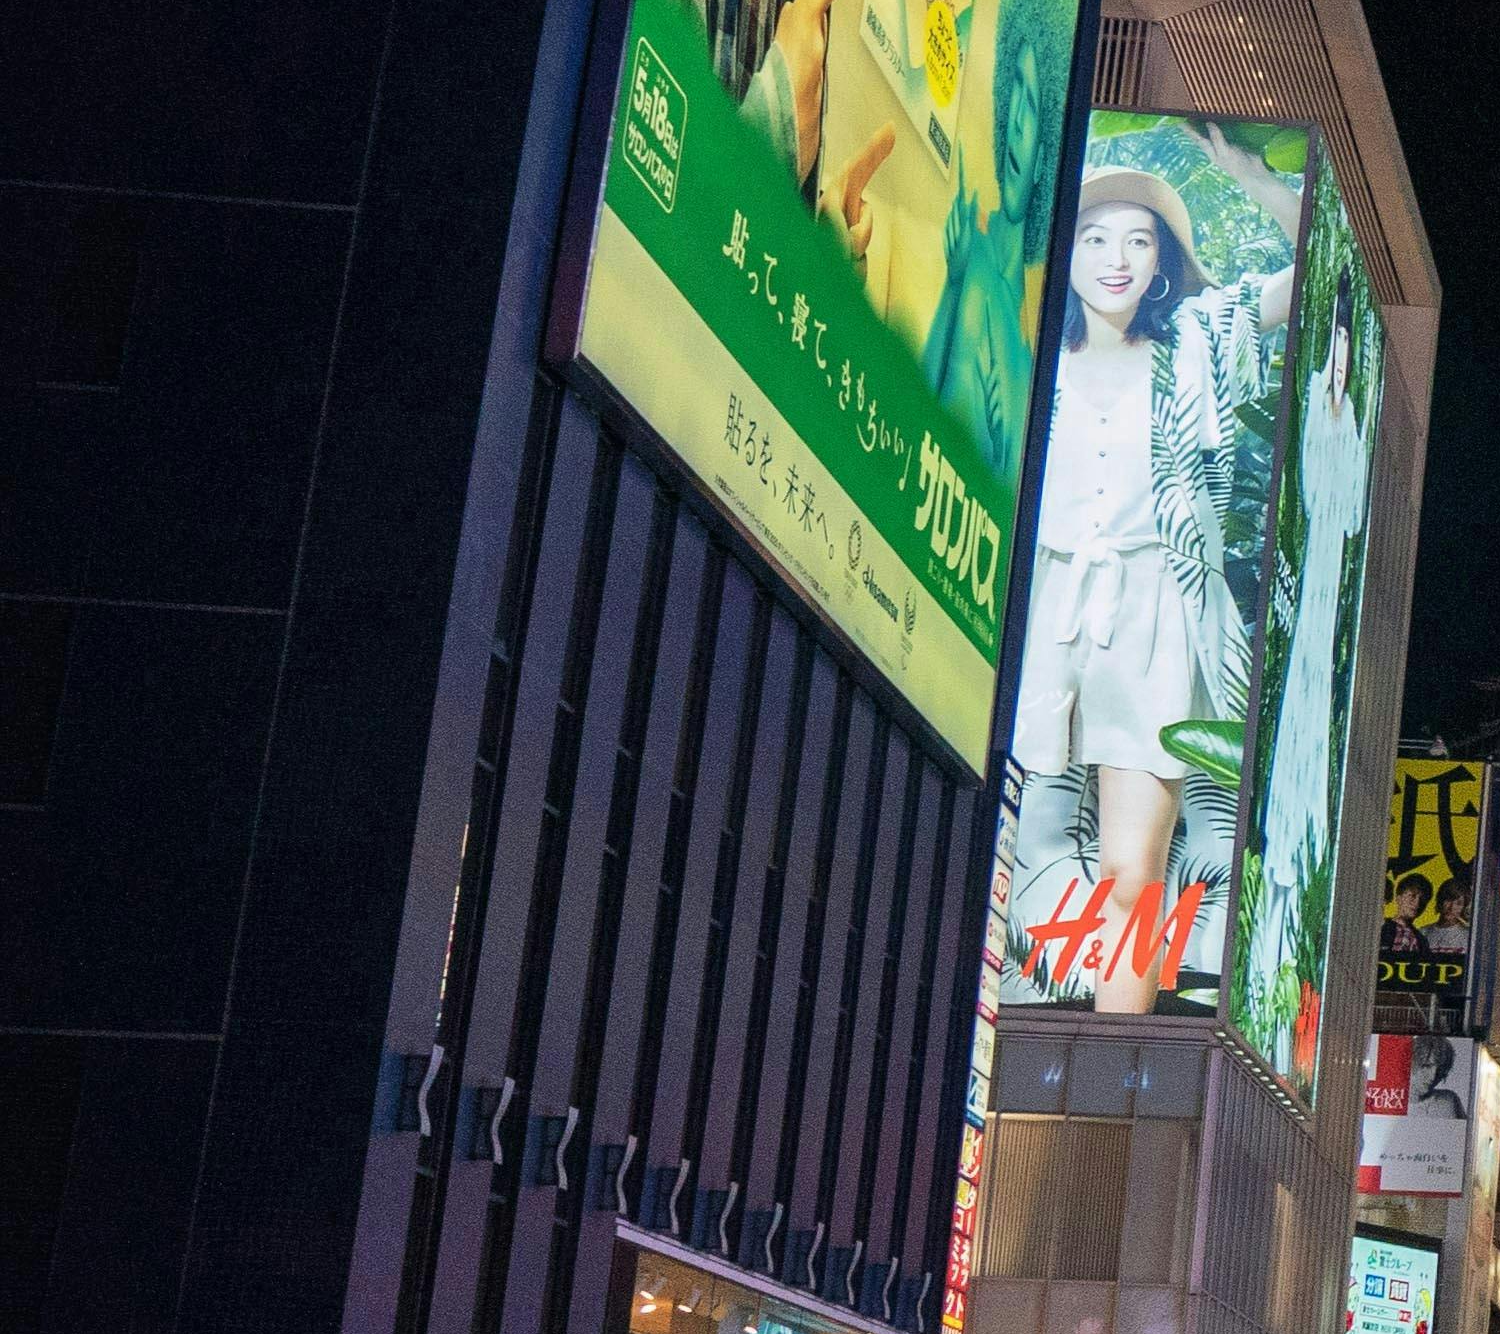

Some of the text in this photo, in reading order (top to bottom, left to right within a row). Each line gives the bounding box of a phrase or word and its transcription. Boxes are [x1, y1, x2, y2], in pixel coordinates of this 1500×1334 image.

[914, 430, 1000, 625] サロンパス
[1021, 875, 1206, 991] H&M
